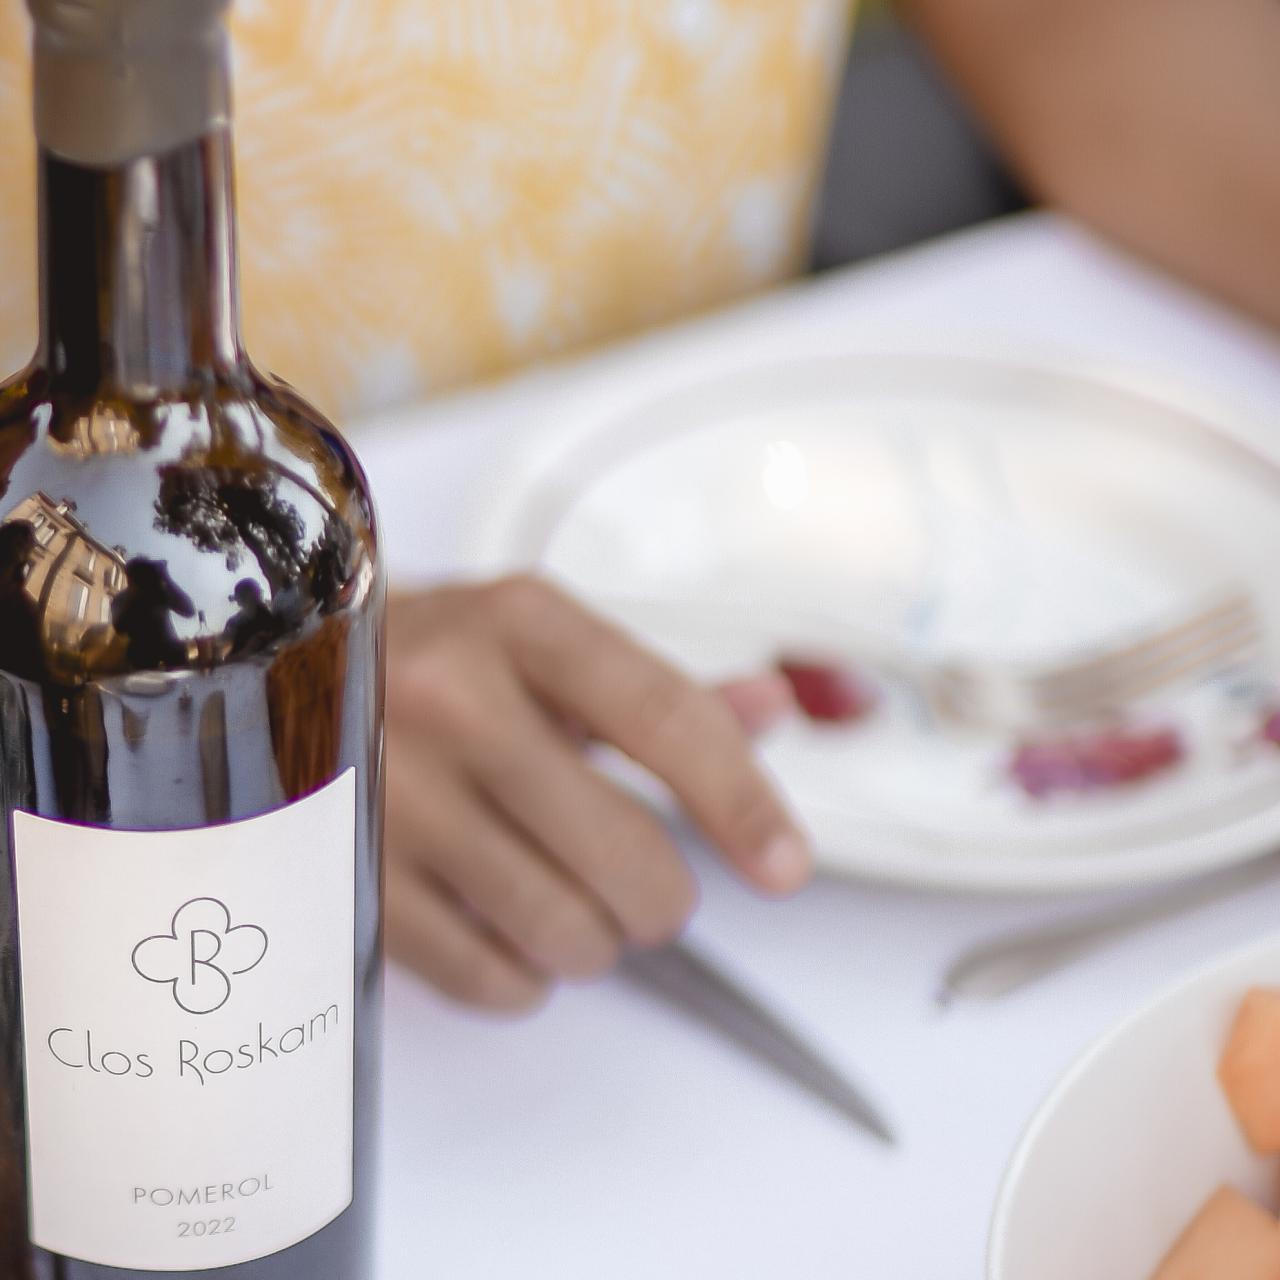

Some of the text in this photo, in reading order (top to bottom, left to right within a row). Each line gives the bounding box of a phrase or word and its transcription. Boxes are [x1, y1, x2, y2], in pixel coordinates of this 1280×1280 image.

[47, 1003, 339, 1086] Clos Roskam
[131, 1173, 275, 1207] POMEROL
[176, 1215, 237, 1238] 2022
